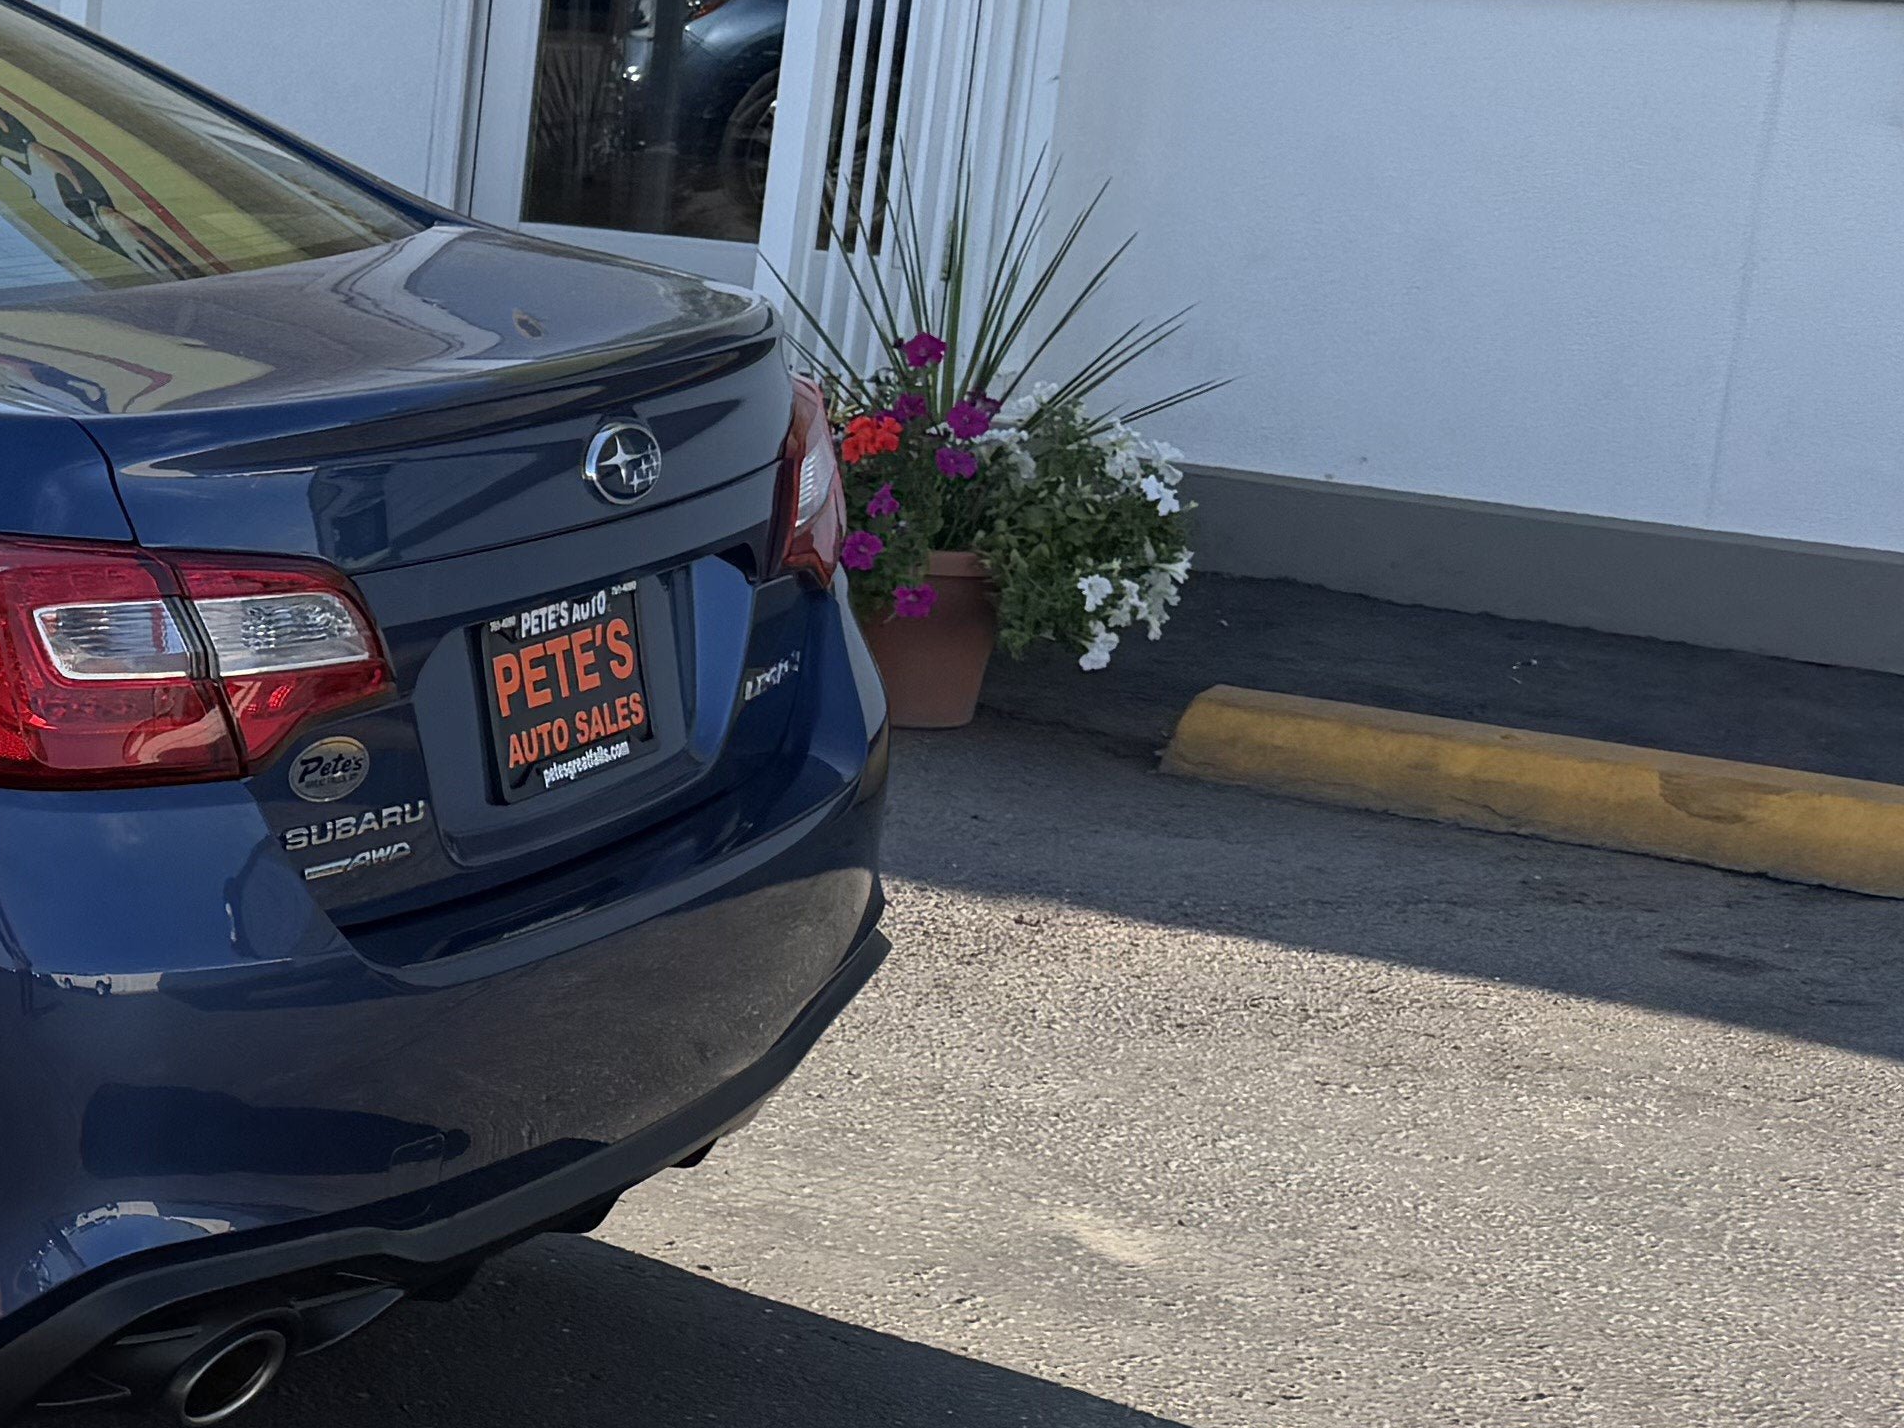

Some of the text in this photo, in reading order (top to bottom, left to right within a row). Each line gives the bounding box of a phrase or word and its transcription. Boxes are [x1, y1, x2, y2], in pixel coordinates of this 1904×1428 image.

[521, 600, 569, 639] PETE'S
[572, 590, 607, 624] AUTO
[493, 618, 634, 718] PETE'S
[508, 691, 646, 769] AUTO SALES
[298, 753, 365, 784] Pete's
[284, 800, 426, 851] SUBARU
[346, 841, 412, 872] AWD
